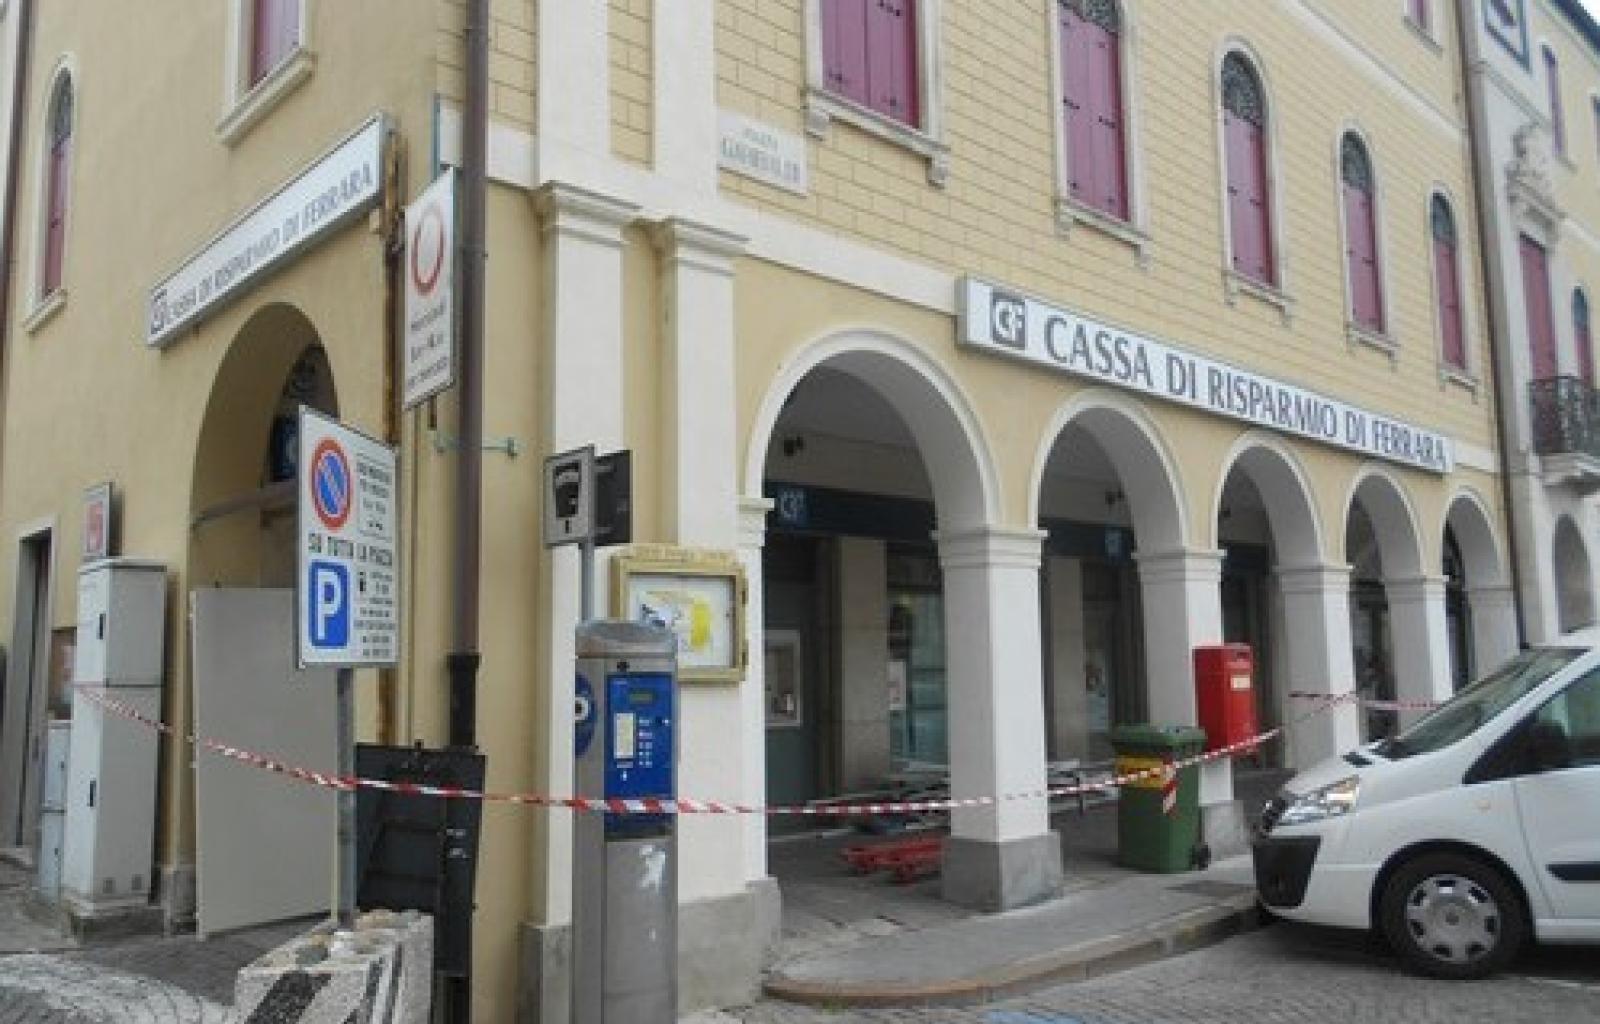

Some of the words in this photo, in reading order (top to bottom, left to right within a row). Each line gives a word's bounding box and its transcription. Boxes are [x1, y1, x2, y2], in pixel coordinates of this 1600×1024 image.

[1043, 315, 1153, 387] CASSA
[1165, 353, 1196, 400] DI
[1207, 365, 1337, 439] RISPARMIO
[1346, 410, 1366, 447] DI
[1372, 420, 1448, 473] FERRARA
[317, 568, 342, 641] P
